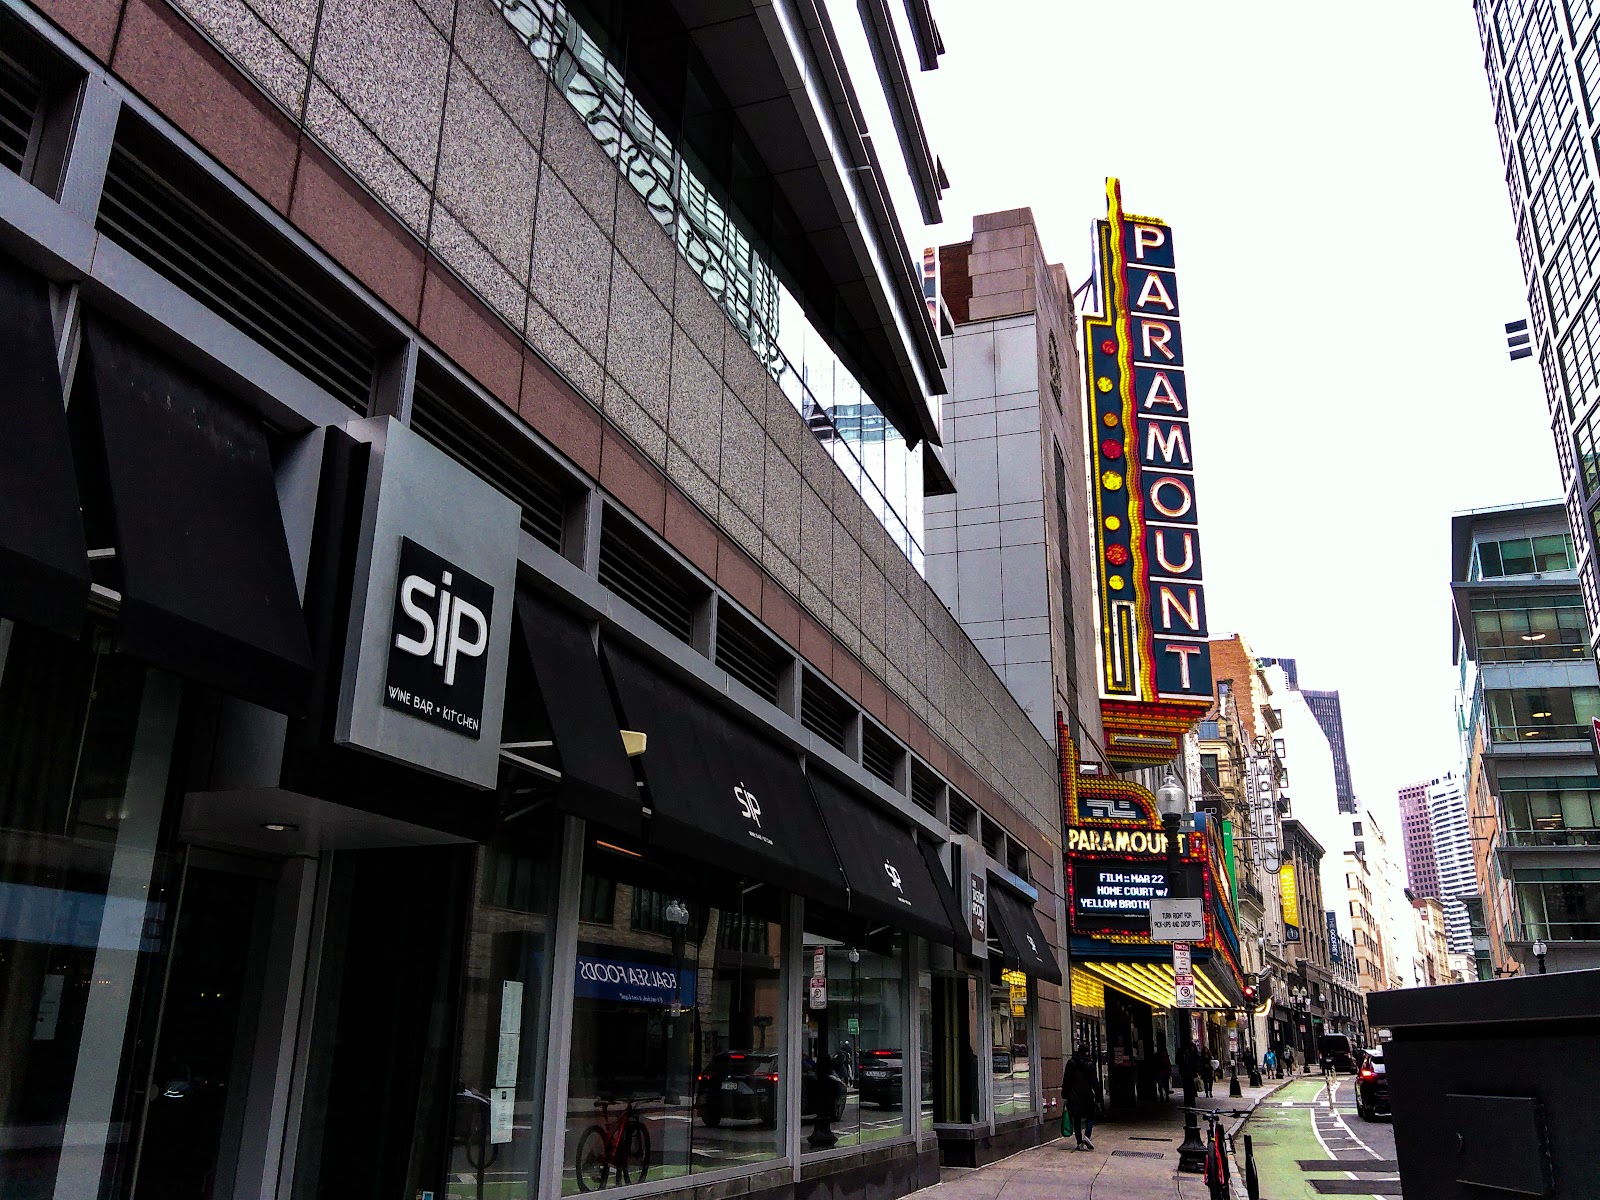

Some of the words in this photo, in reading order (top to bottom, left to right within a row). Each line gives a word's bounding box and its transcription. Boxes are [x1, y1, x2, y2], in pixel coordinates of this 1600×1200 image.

[1132, 223, 1202, 690] PARAMOUNT
[388, 684, 411, 706] WINE
[413, 695, 434, 716] BAR
[442, 705, 479, 732] KITCHEN
[1099, 872, 1123, 883] FILM
[1131, 873, 1151, 884] MAR
[1151, 874, 1165, 884] 22
[1097, 885, 1123, 896] HOME
[1124, 886, 1154, 897] COURT
[1080, 898, 1118, 909] YELLOW
